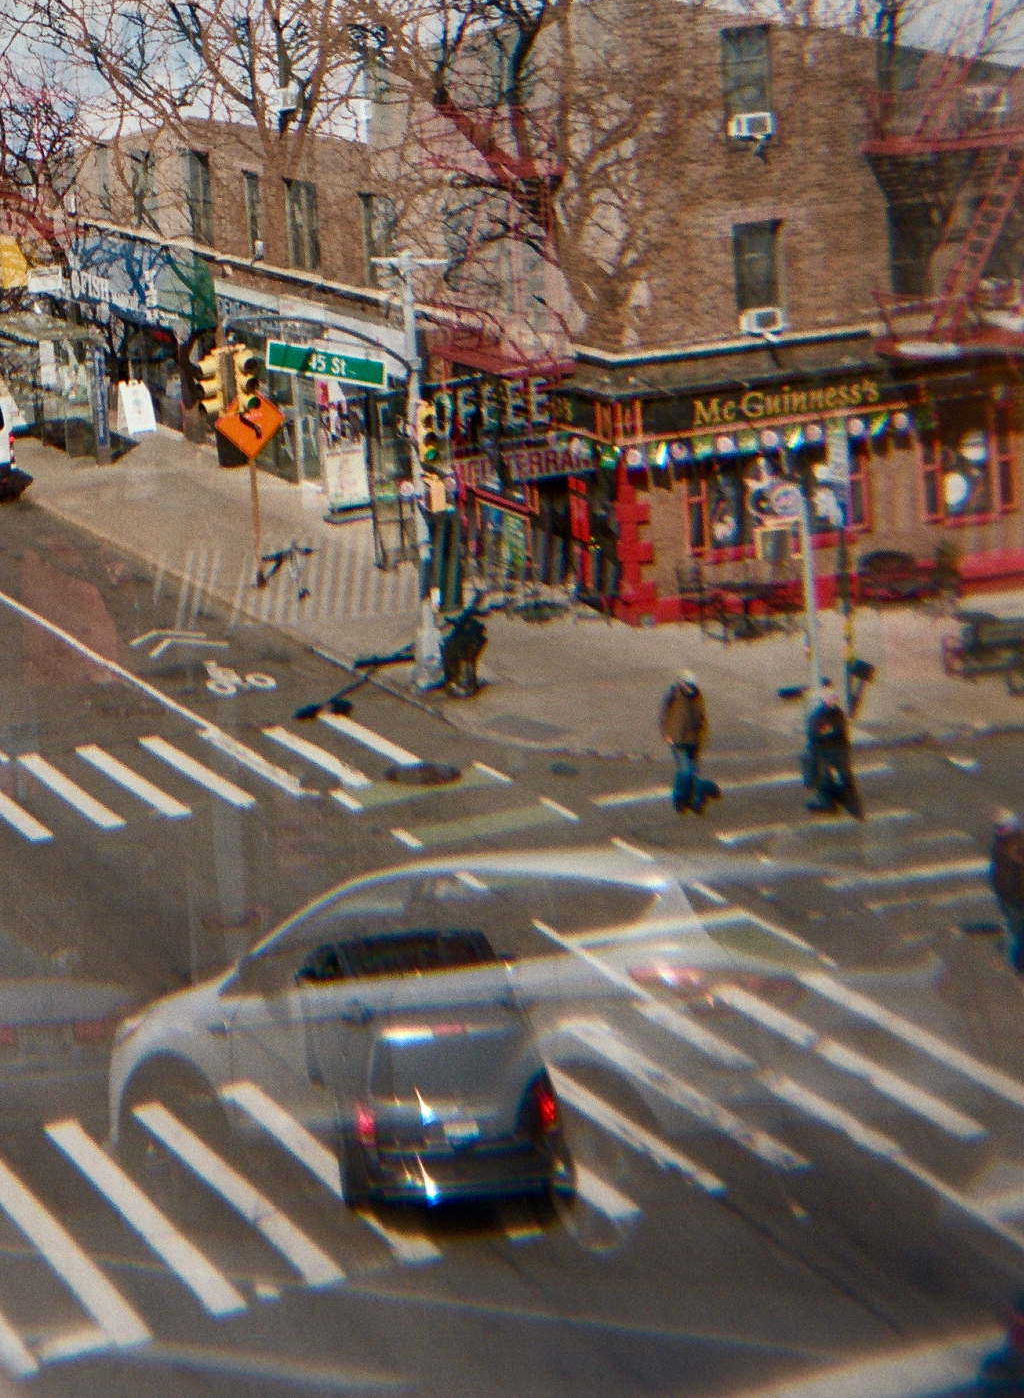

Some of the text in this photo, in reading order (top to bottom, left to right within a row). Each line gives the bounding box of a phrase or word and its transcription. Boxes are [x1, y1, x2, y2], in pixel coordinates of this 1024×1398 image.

[308, 353, 348, 377] 45 St
[431, 376, 552, 439] OFFEE
